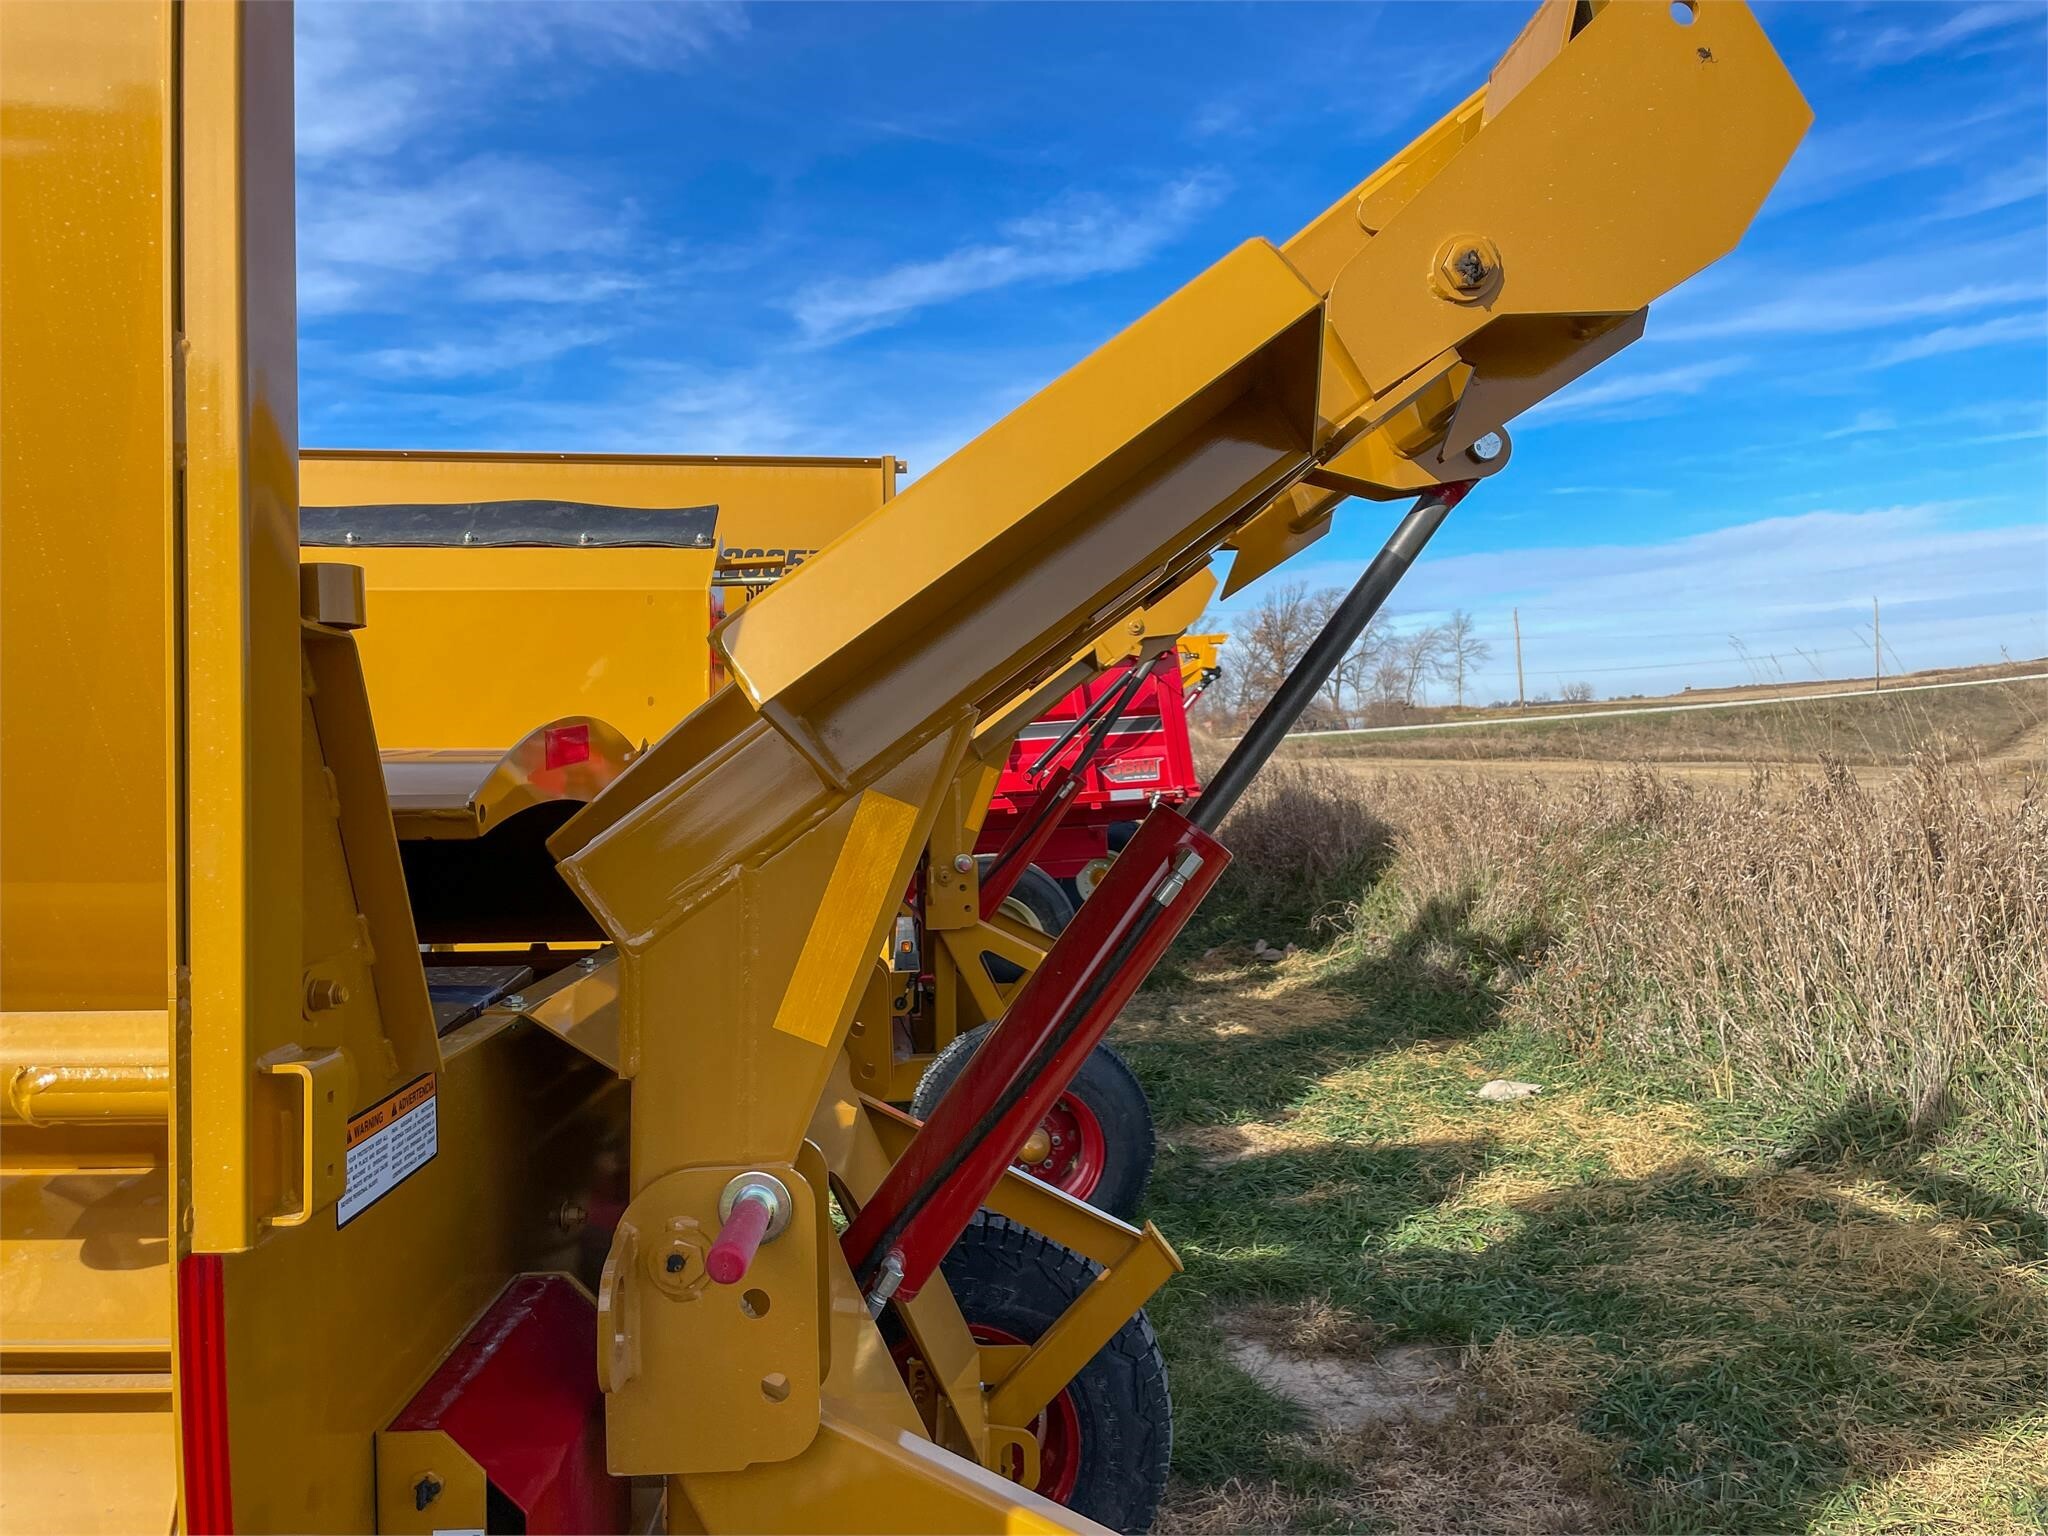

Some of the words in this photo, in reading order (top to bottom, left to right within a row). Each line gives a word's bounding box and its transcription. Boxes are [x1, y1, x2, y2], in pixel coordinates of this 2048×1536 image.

[1108, 759, 1156, 775] JBM
[354, 1111, 383, 1138] WARNING
[399, 1080, 434, 1110] ADVERTENCIA
